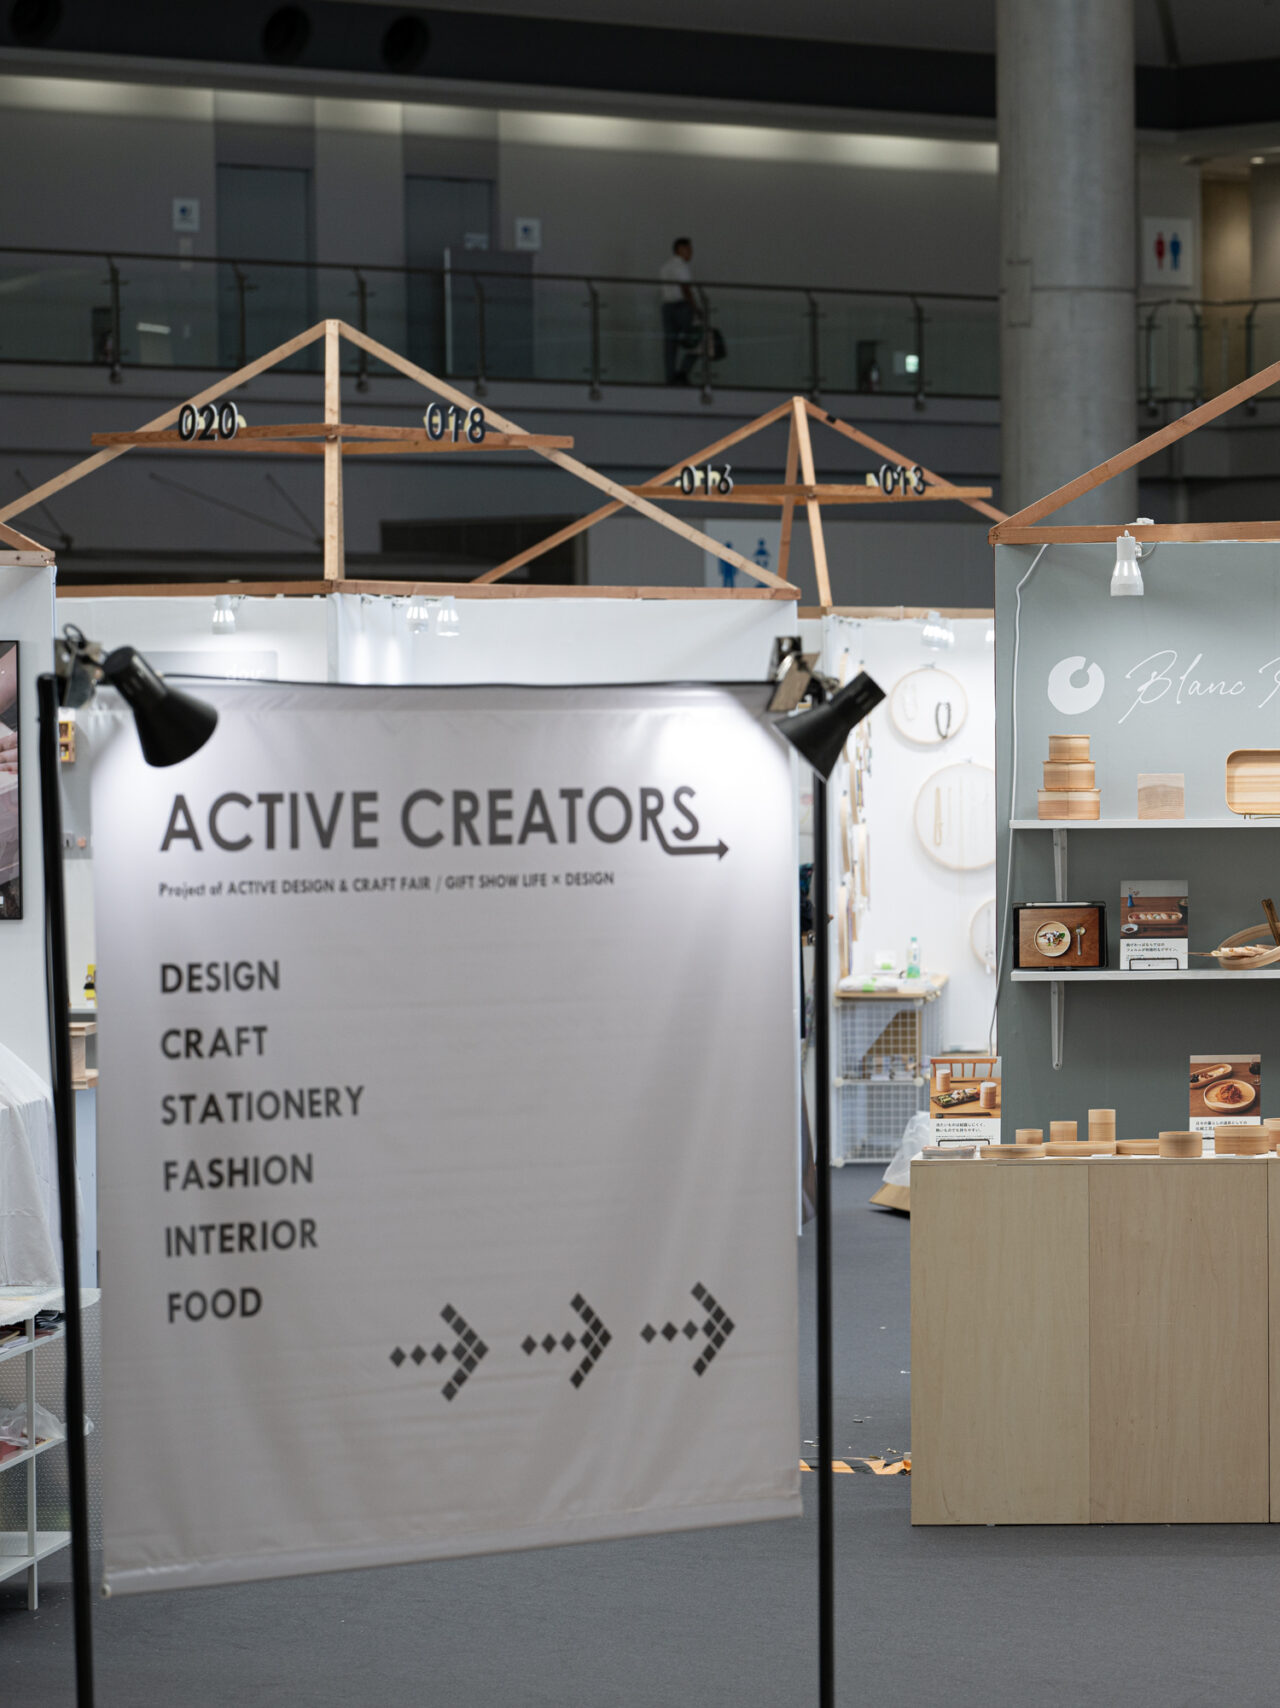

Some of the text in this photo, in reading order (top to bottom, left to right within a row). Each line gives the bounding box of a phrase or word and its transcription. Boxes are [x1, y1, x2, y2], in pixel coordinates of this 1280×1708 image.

[178, 401, 238, 442] 020
[425, 402, 486, 443] 018
[879, 463, 926, 496] 013
[1117, 649, 1246, 724] Blanc
[159, 785, 702, 855] ACTIVE CREATORS
[159, 882, 206, 899] Project
[209, 883, 223, 896] of
[227, 879, 276, 895] ACTIVE
[282, 878, 335, 894] DESIGN
[338, 878, 348, 893] &
[352, 877, 397, 892] CRAFT
[400, 876, 431, 890] FAIR
[444, 874, 475, 890] GIFT
[479, 873, 520, 889] SHOW
[523, 872, 548, 887] LIFE
[565, 872, 615, 886] DESIGN
[161, 959, 280, 994] DESIGN
[161, 1025, 268, 1060] CRAFT
[161, 1085, 364, 1126] STATIONERY
[164, 1152, 313, 1192] FASHION
[165, 1217, 318, 1258] INTERIOR
[168, 1286, 262, 1324] FOOD
